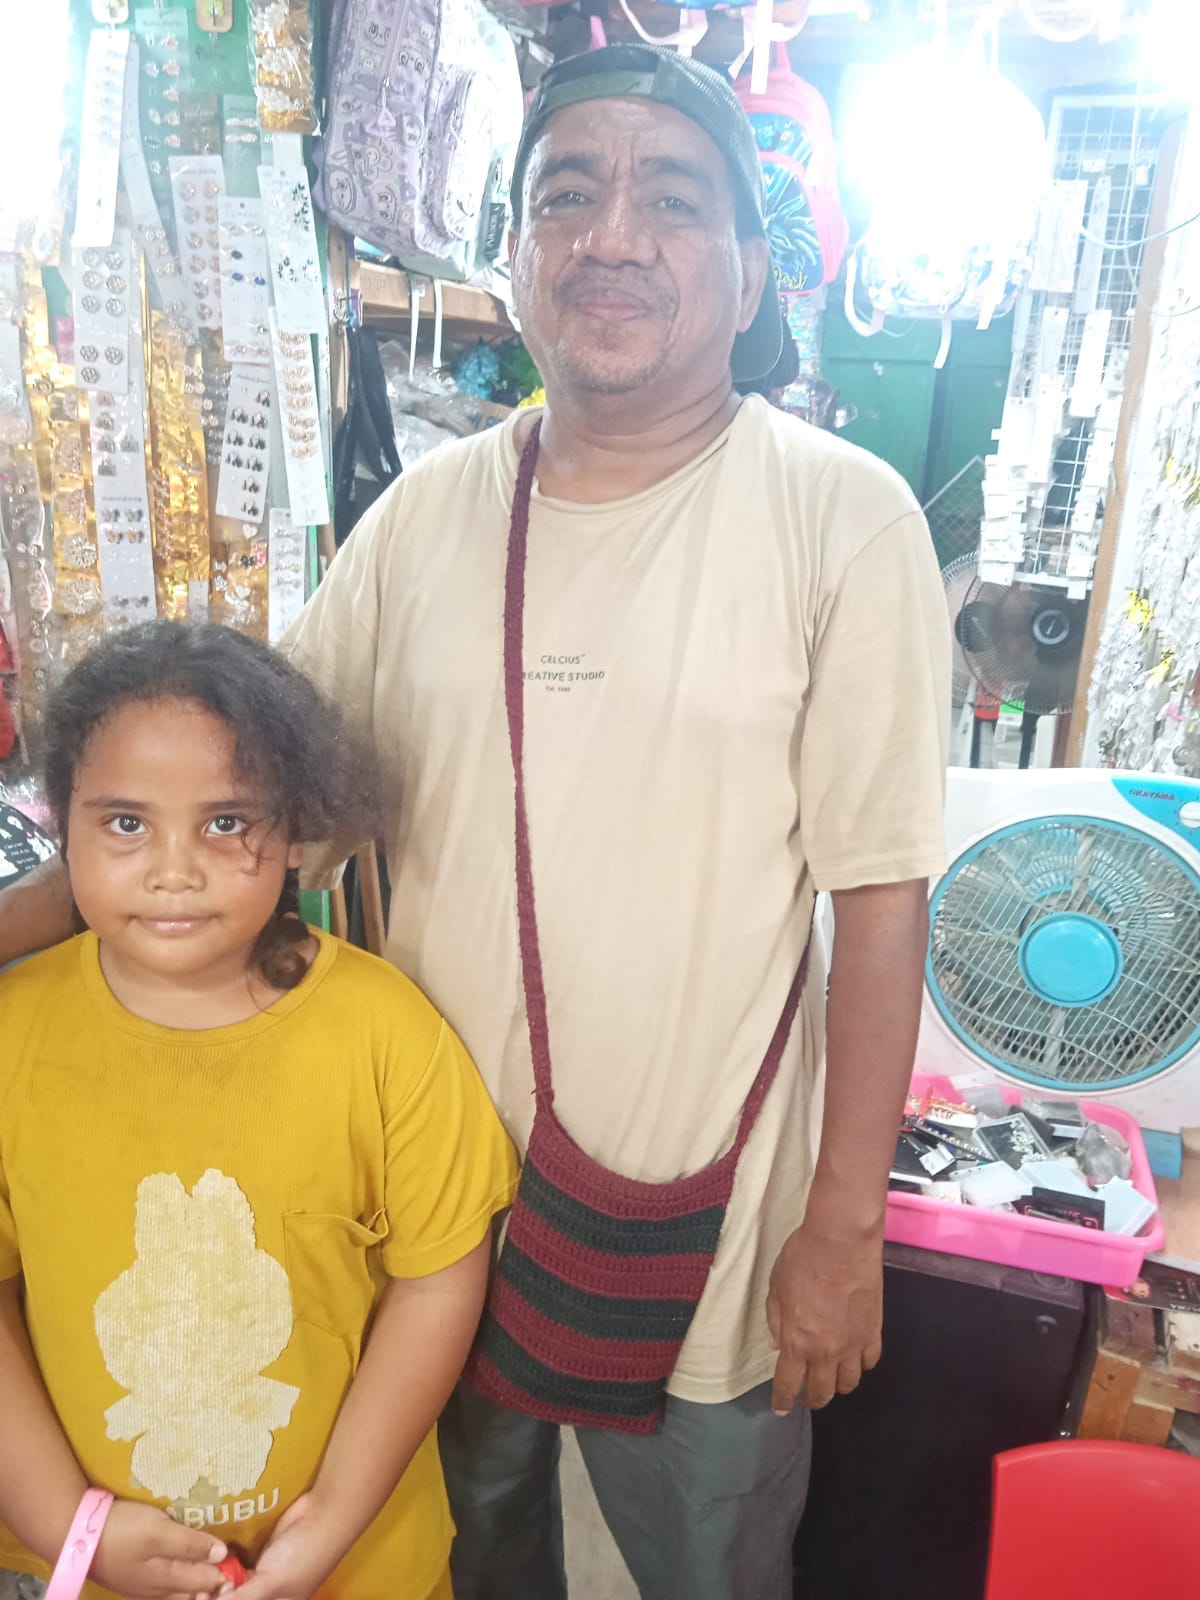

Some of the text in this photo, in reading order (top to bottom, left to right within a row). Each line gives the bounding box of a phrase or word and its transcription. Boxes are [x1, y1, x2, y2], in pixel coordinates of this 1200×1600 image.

[522, 670, 605, 682] REATIVE STUDIO
[1128, 788, 1175, 801] OKAYAMA
